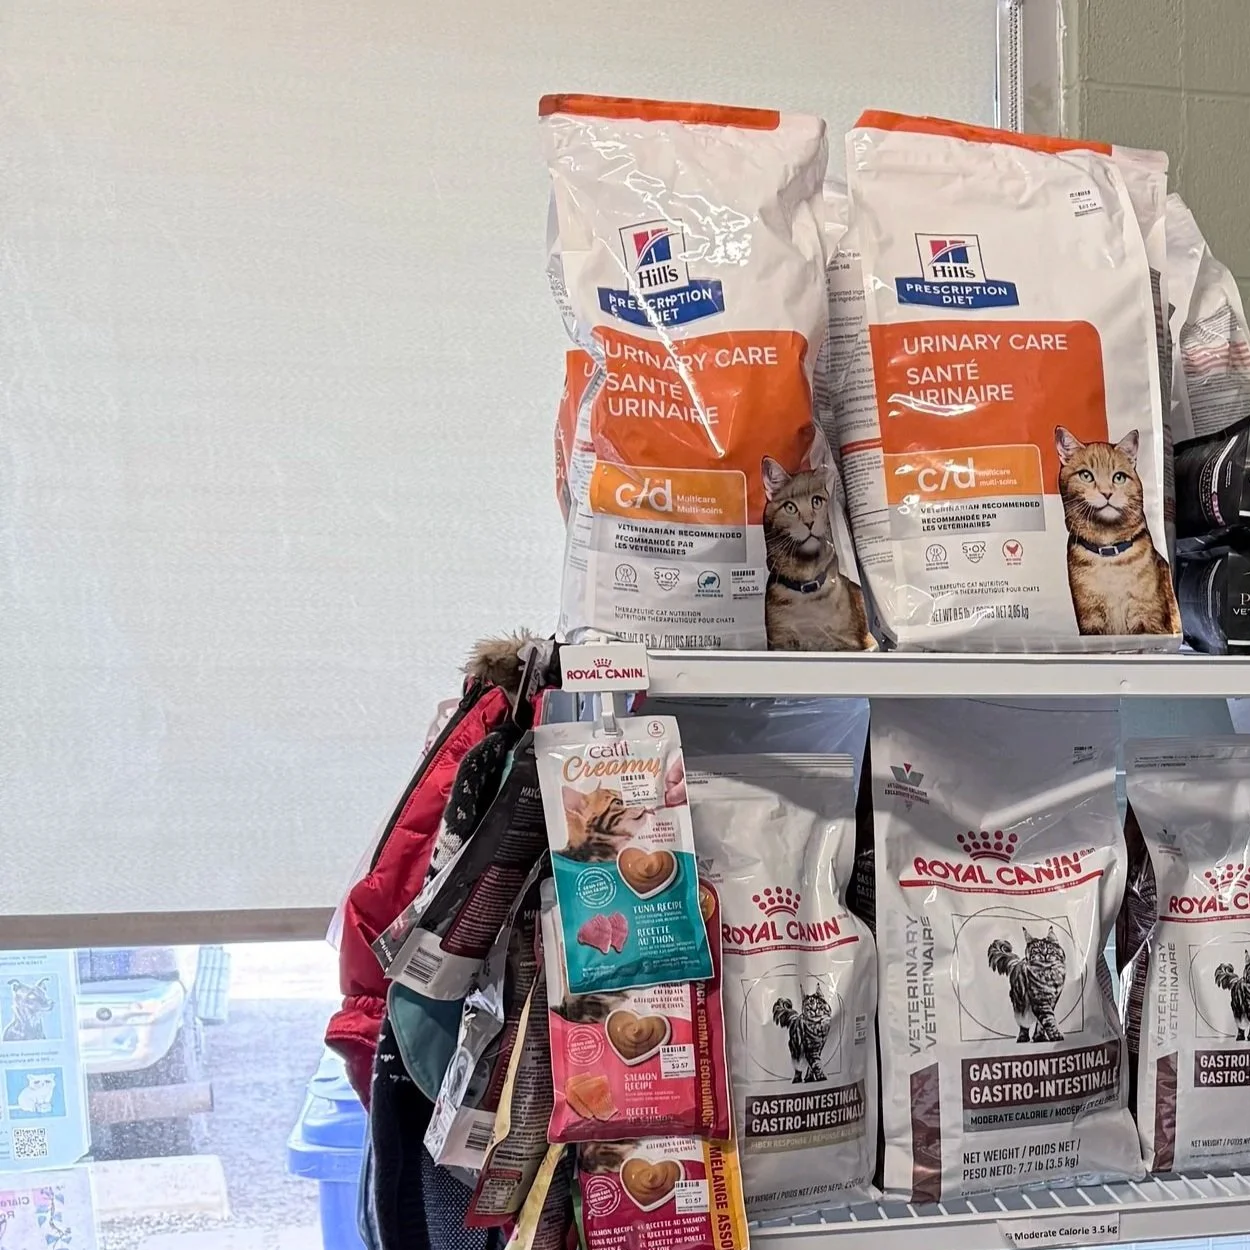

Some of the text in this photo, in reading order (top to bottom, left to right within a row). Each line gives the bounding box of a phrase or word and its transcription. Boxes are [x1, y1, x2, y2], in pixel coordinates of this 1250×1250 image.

[638, 265, 679, 289] Hill's
[905, 284, 1008, 297] PRESCRIPTION
[942, 295, 975, 306] DIET
[903, 333, 1068, 356] URINARY CARE
[604, 341, 778, 372] URINARY CARE
[906, 359, 980, 386] SANTÉ
[567, 669, 643, 680] ROYAL CANIN
[653, 723, 659, 731] 5
[563, 756, 663, 782] Creamy
[913, 852, 1082, 885] ROYAL CANIN
[1157, 941, 1169, 1046] VETERINARY
[624, 1073, 658, 1082] SALMON
[624, 1082, 653, 1091] RECIPE
[963, 1152, 980, 1164] NET
[983, 1147, 1019, 1162] WEIGHT
[1029, 1143, 1056, 1157] POIDS
[1058, 1141, 1074, 1155] NET
[1014, 1229, 1057, 1241] Moderate
[1058, 1227, 1089, 1236] Calorie
[1092, 1225, 1105, 1234] 3.5
[1107, 1225, 1118, 1234] kg
